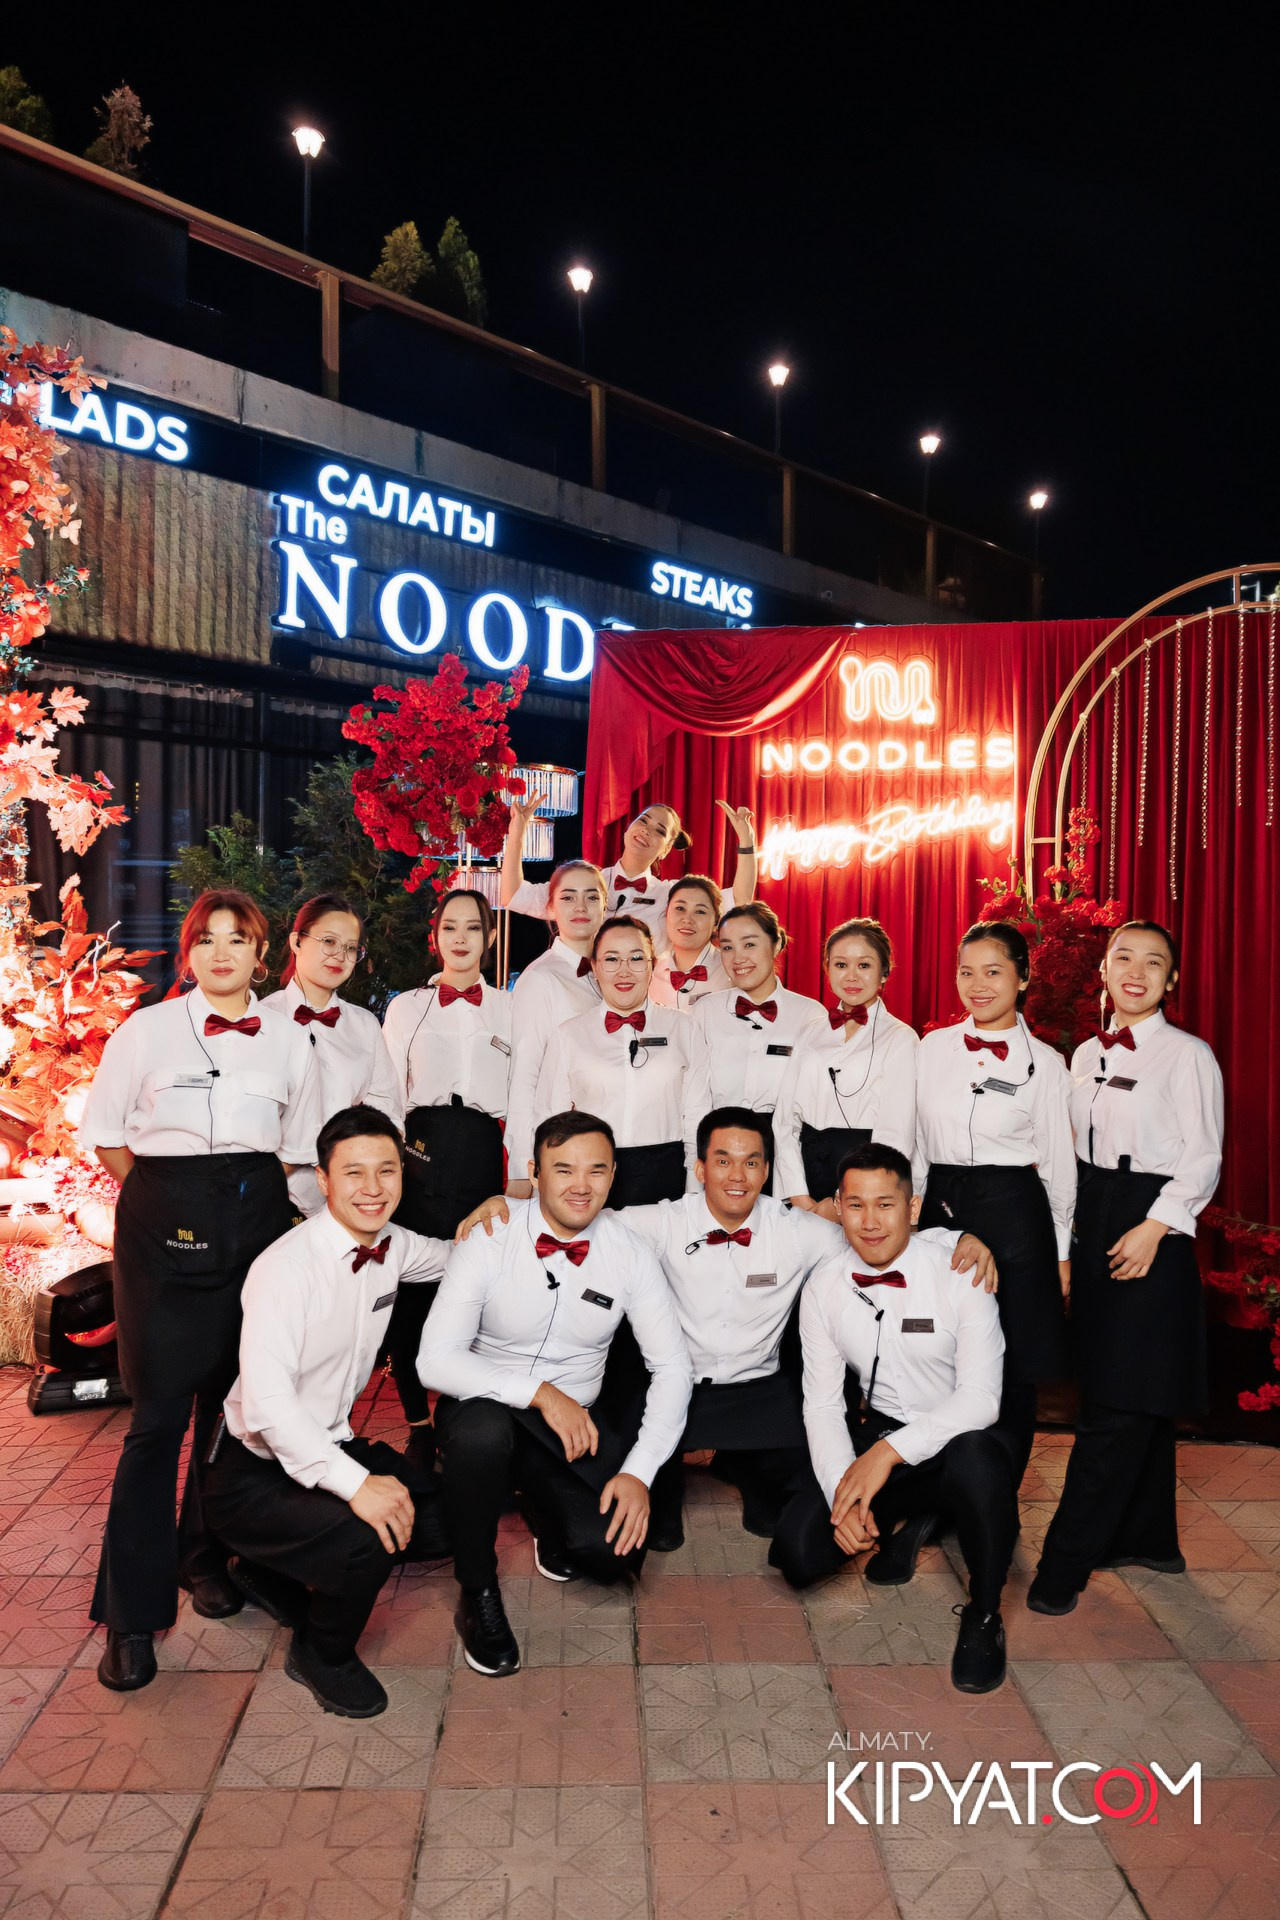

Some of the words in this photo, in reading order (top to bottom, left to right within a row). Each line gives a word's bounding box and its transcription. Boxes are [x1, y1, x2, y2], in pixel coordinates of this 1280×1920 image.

[0, 377, 189, 462] LADS
[279, 494, 348, 545] The
[317, 463, 496, 548] САЛАТЫ
[275, 538, 597, 682] NOOD
[650, 561, 754, 619] STEAKS
[760, 736, 1015, 772] NOODLES
[404, 1145, 431, 1162] NOODLES
[166, 1239, 209, 1250] NOODLES
